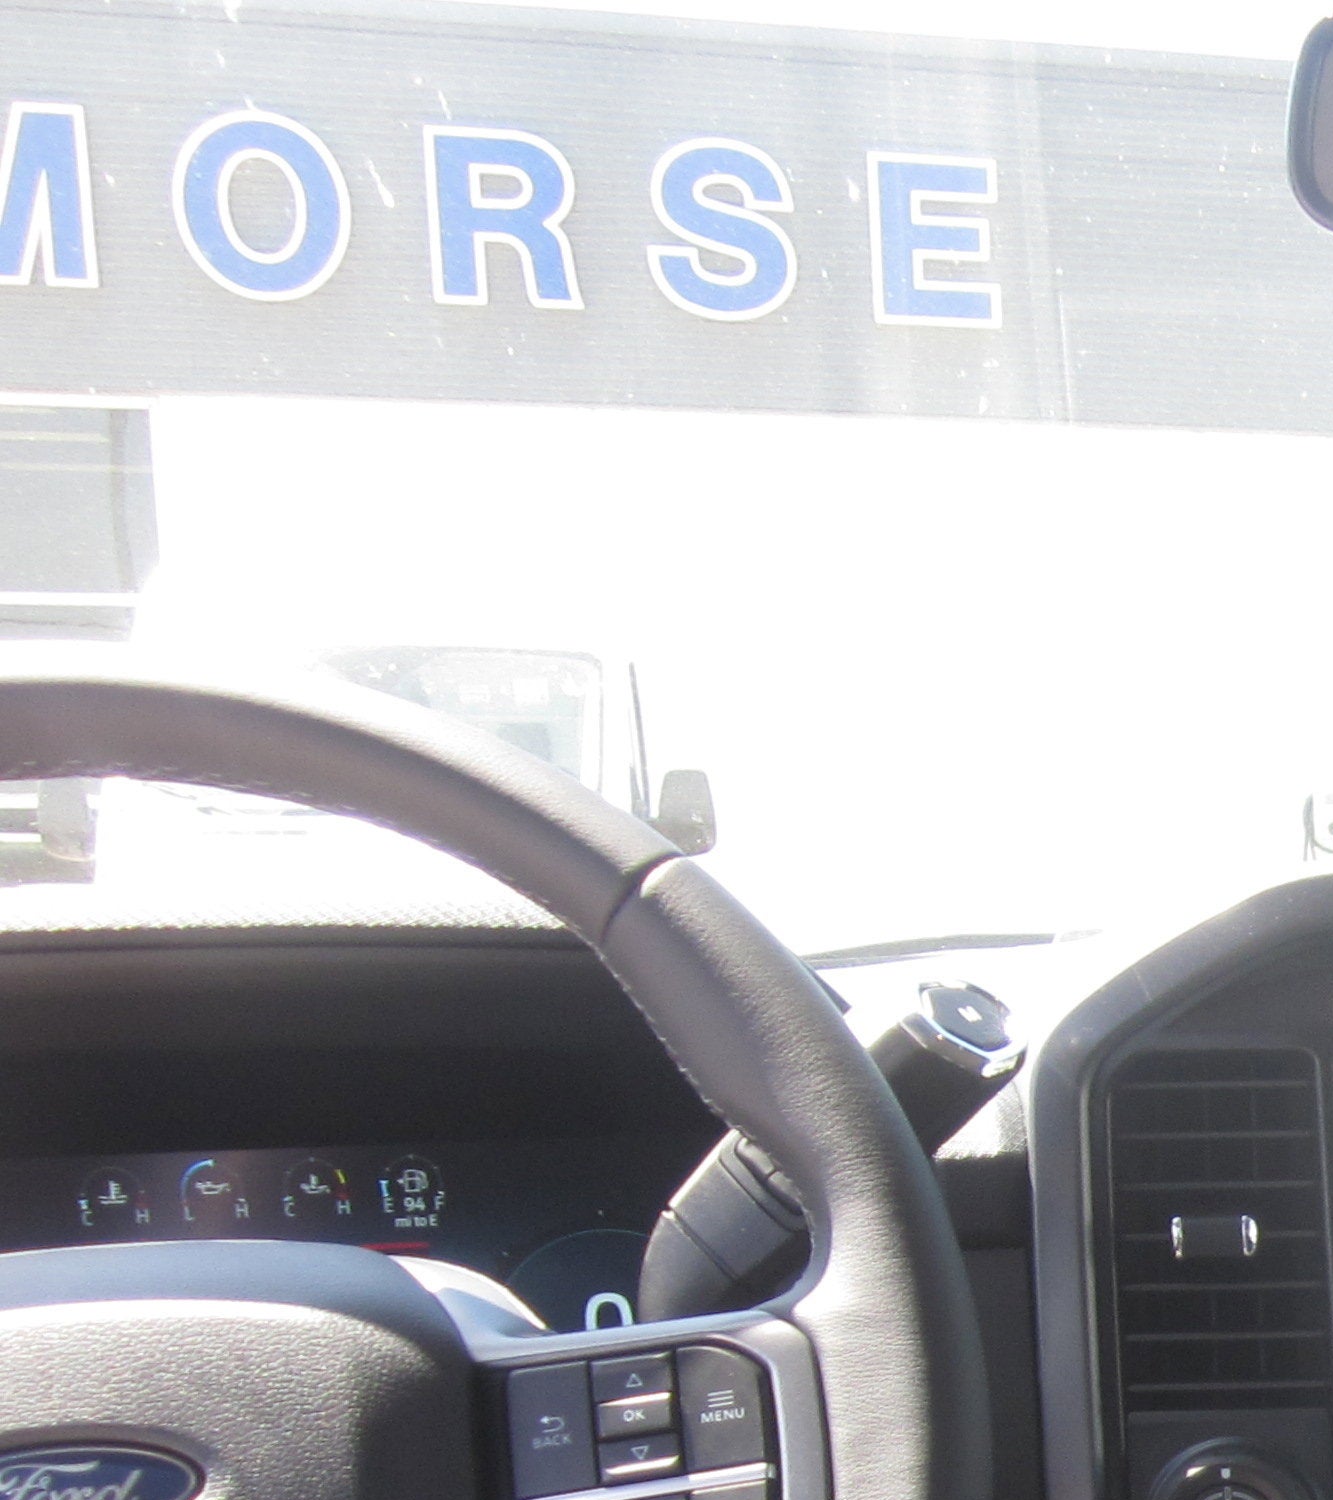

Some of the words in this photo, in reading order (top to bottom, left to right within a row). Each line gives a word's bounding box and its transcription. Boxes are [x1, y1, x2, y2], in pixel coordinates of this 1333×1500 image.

[403, 1197, 426, 1213] 94
[395, 1217, 411, 1228] mi
[414, 1216, 427, 1227] to
[623, 1409, 646, 1423] OK
[700, 1407, 745, 1424] MENU
[532, 1433, 573, 1450] BACK
